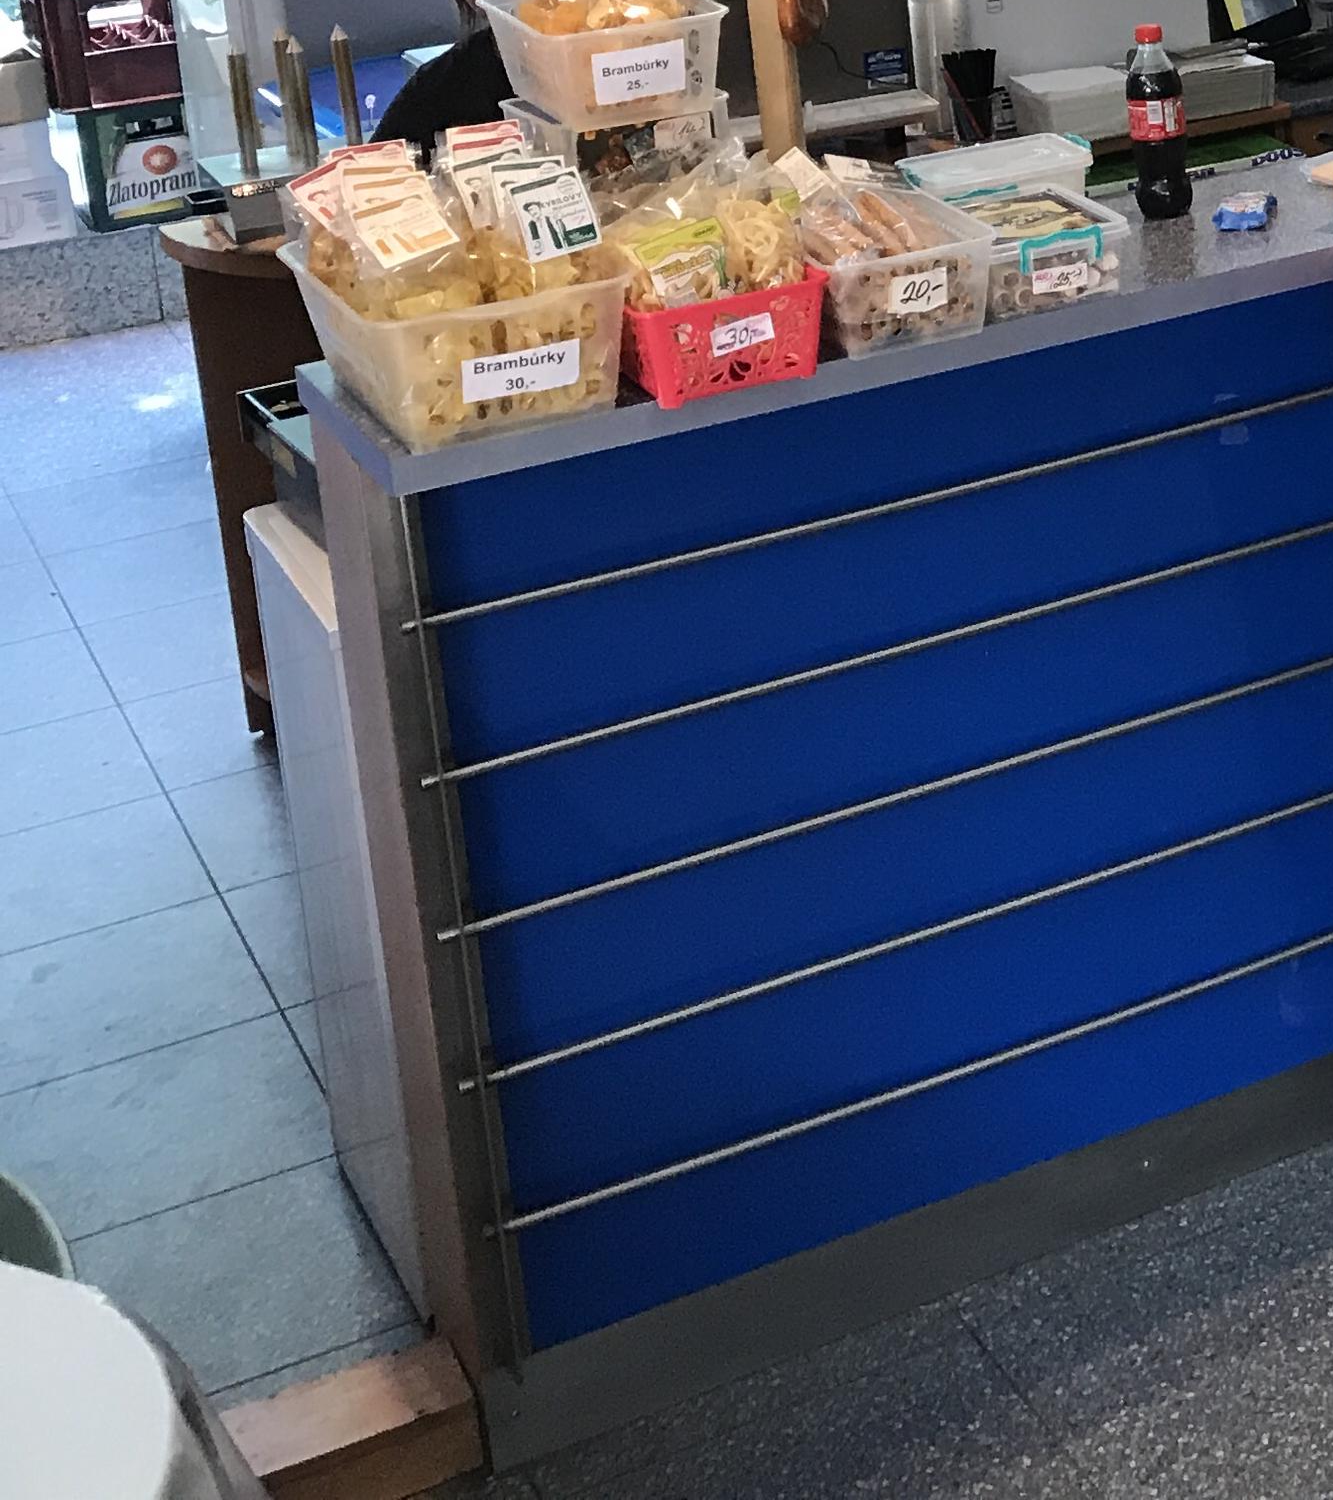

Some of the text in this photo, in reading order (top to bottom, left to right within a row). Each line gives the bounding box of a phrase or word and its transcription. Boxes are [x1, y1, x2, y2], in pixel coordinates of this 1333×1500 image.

[602, 57, 670, 78] Brambůrky
[626, 79, 651, 91] 25,-
[108, 169, 197, 207] Zlatopram
[900, 279, 945, 306] 20,-
[473, 350, 566, 376] Brambůrky
[505, 378, 537, 391] 30,-
